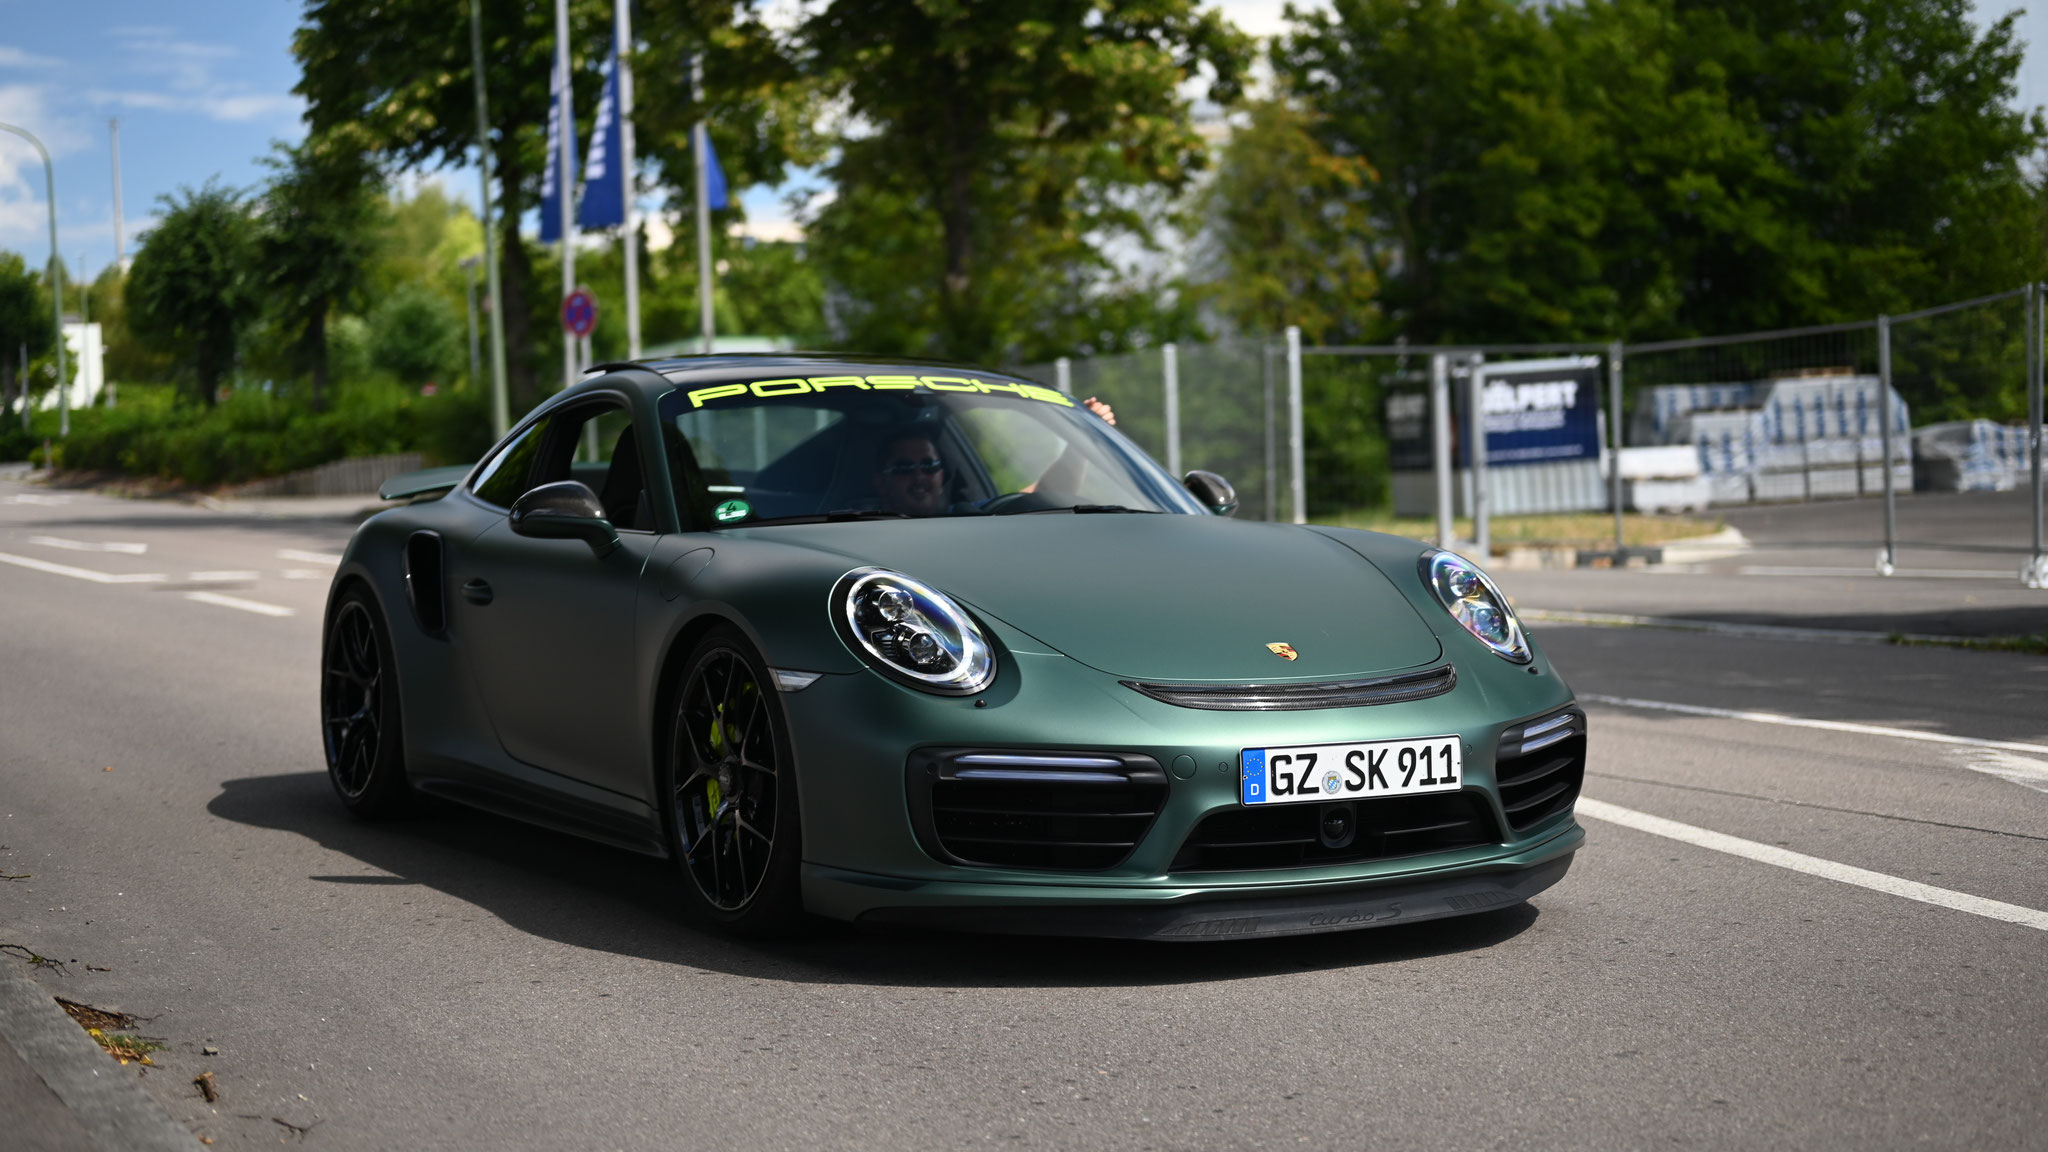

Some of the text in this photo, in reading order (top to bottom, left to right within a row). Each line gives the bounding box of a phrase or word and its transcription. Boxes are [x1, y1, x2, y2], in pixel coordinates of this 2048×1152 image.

[687, 375, 1076, 408] PORSCHE
[1270, 744, 1458, 796] GZ SK 911
[1250, 783, 1260, 796] D
